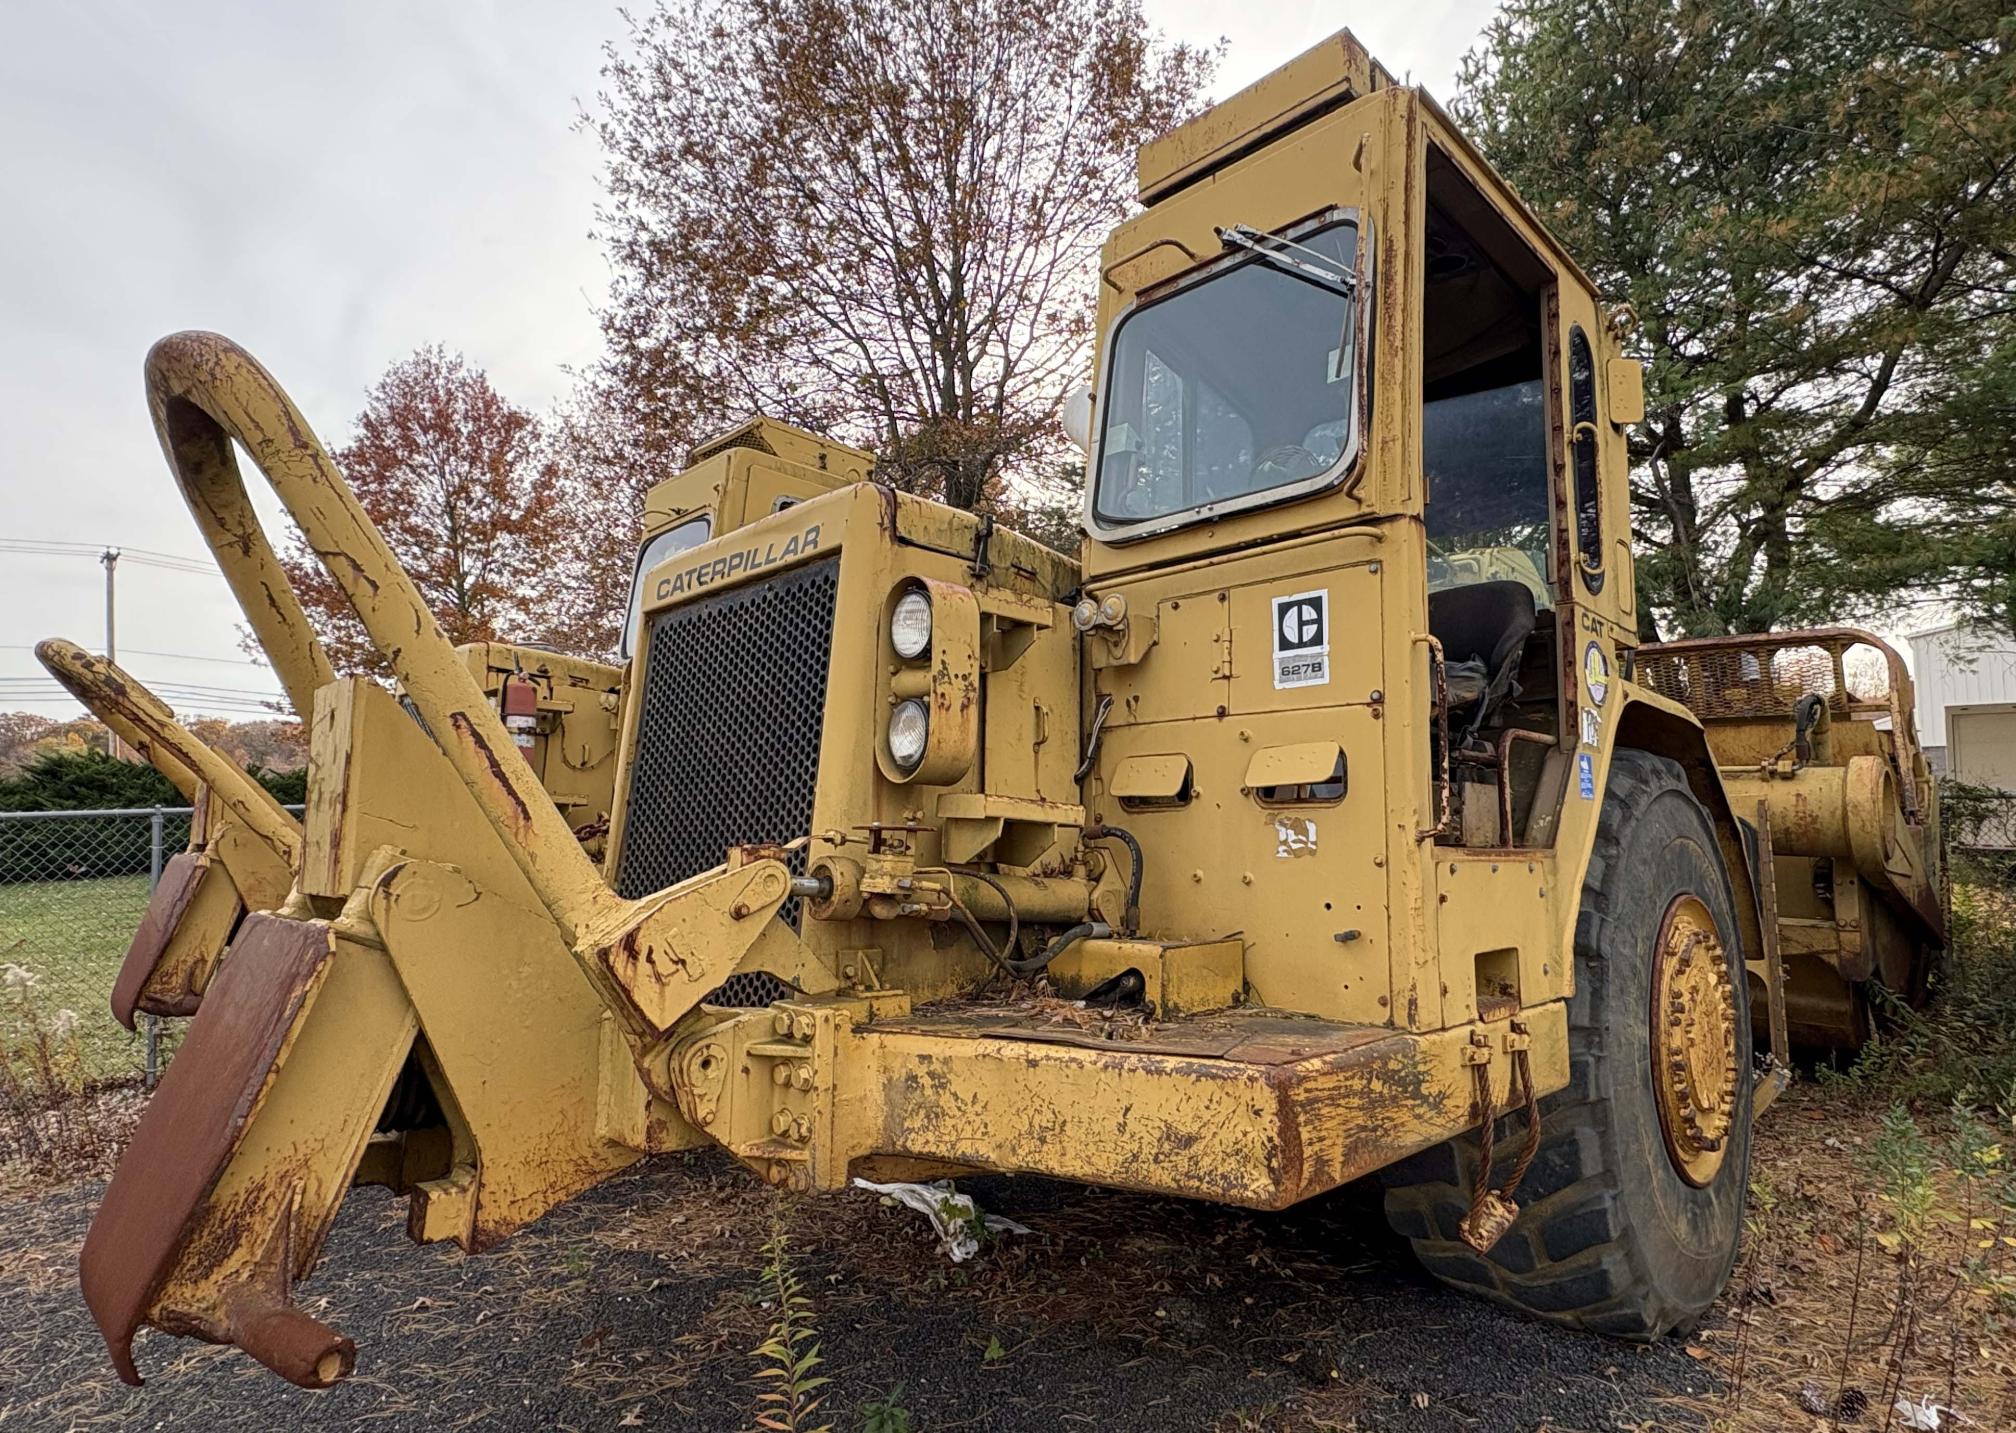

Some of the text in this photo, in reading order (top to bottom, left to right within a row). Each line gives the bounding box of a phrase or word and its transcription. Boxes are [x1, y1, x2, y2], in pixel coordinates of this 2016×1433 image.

[656, 525, 821, 601] CATERPILLAR
[1581, 612, 1604, 638] CAT
[1281, 662, 1322, 676] 627B
